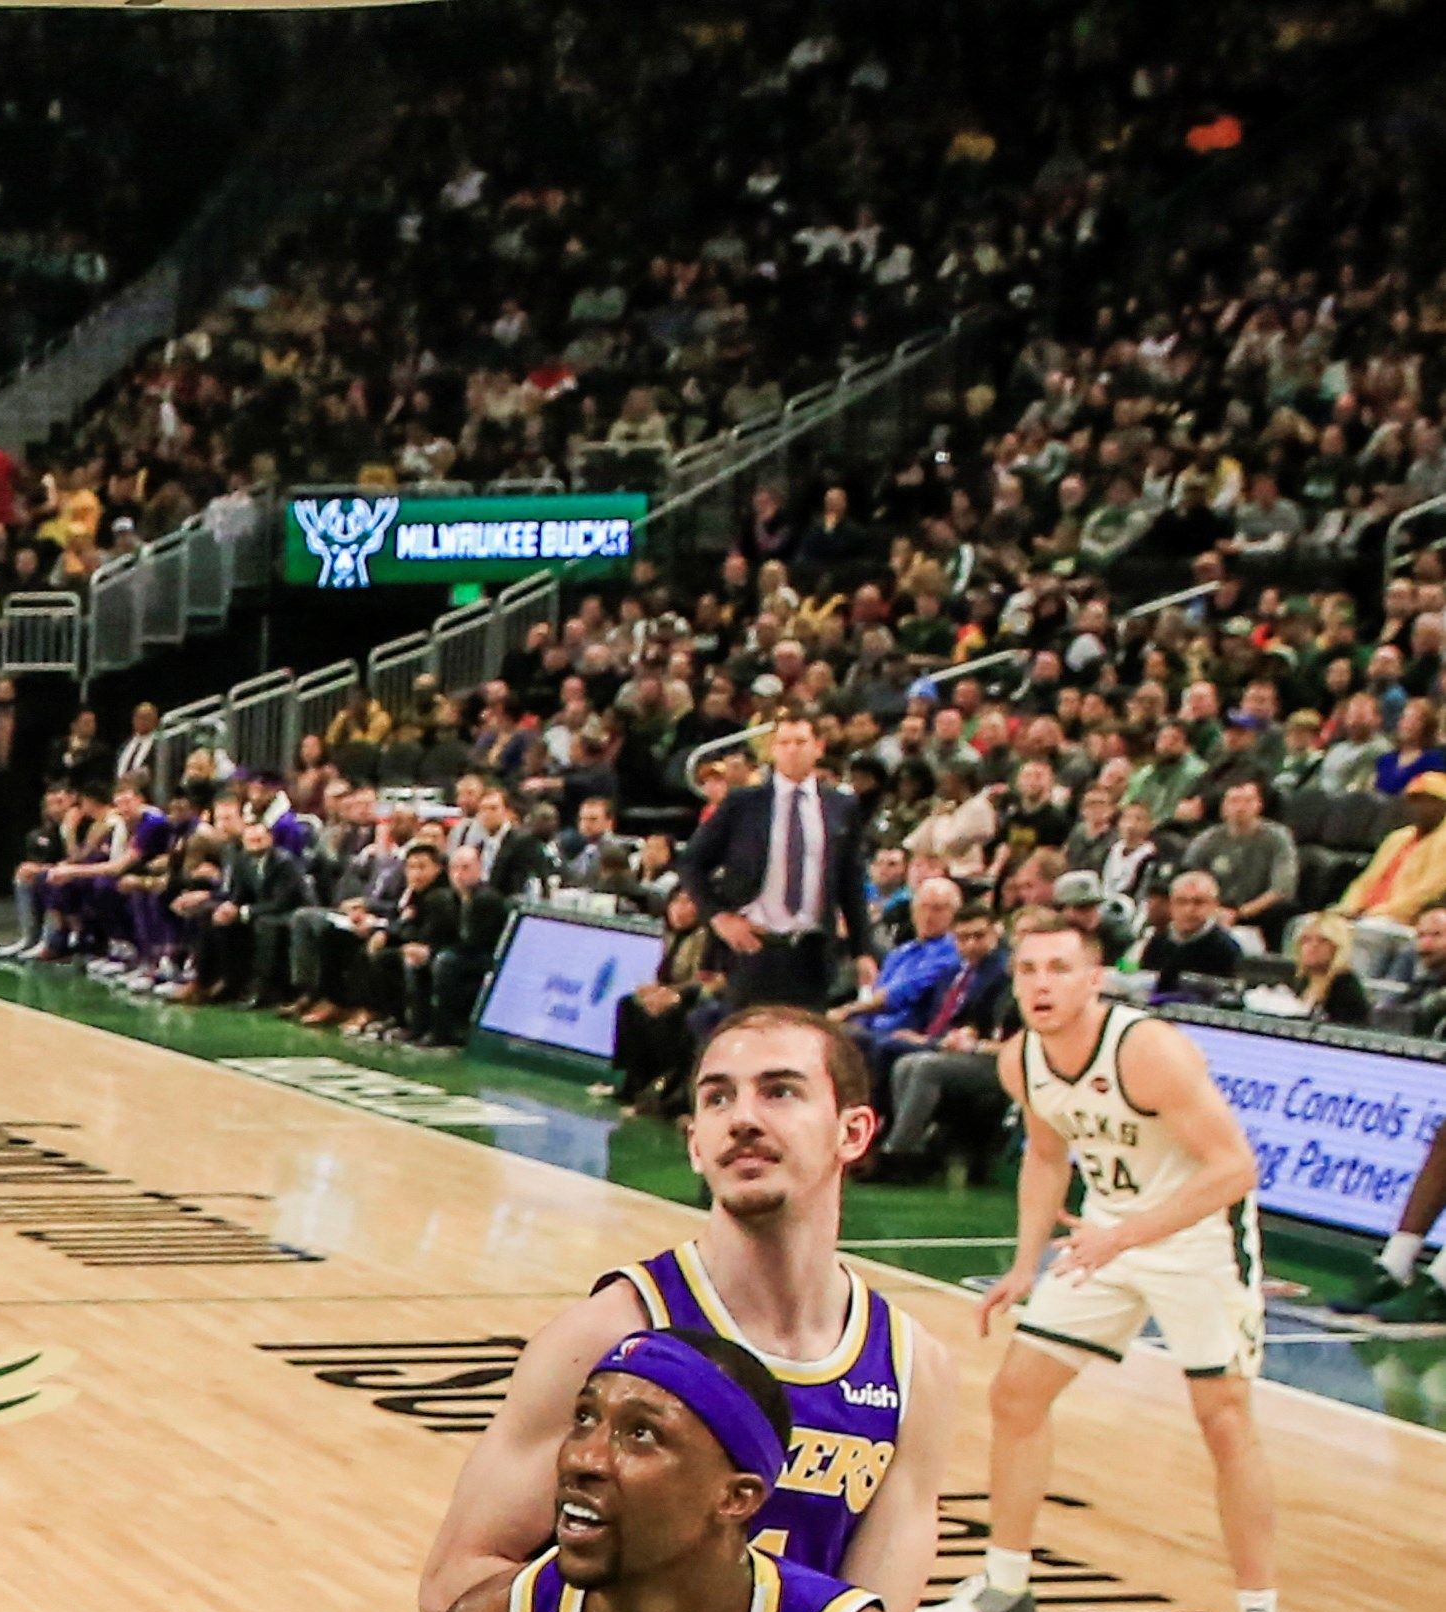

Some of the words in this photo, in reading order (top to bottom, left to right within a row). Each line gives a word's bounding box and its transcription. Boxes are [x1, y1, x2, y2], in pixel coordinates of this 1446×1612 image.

[397, 521, 538, 559] MILWAUKEE
[540, 519, 631, 558] BUCKS
[1282, 1077, 1410, 1139] Controls
[839, 1379, 899, 1410] wish
